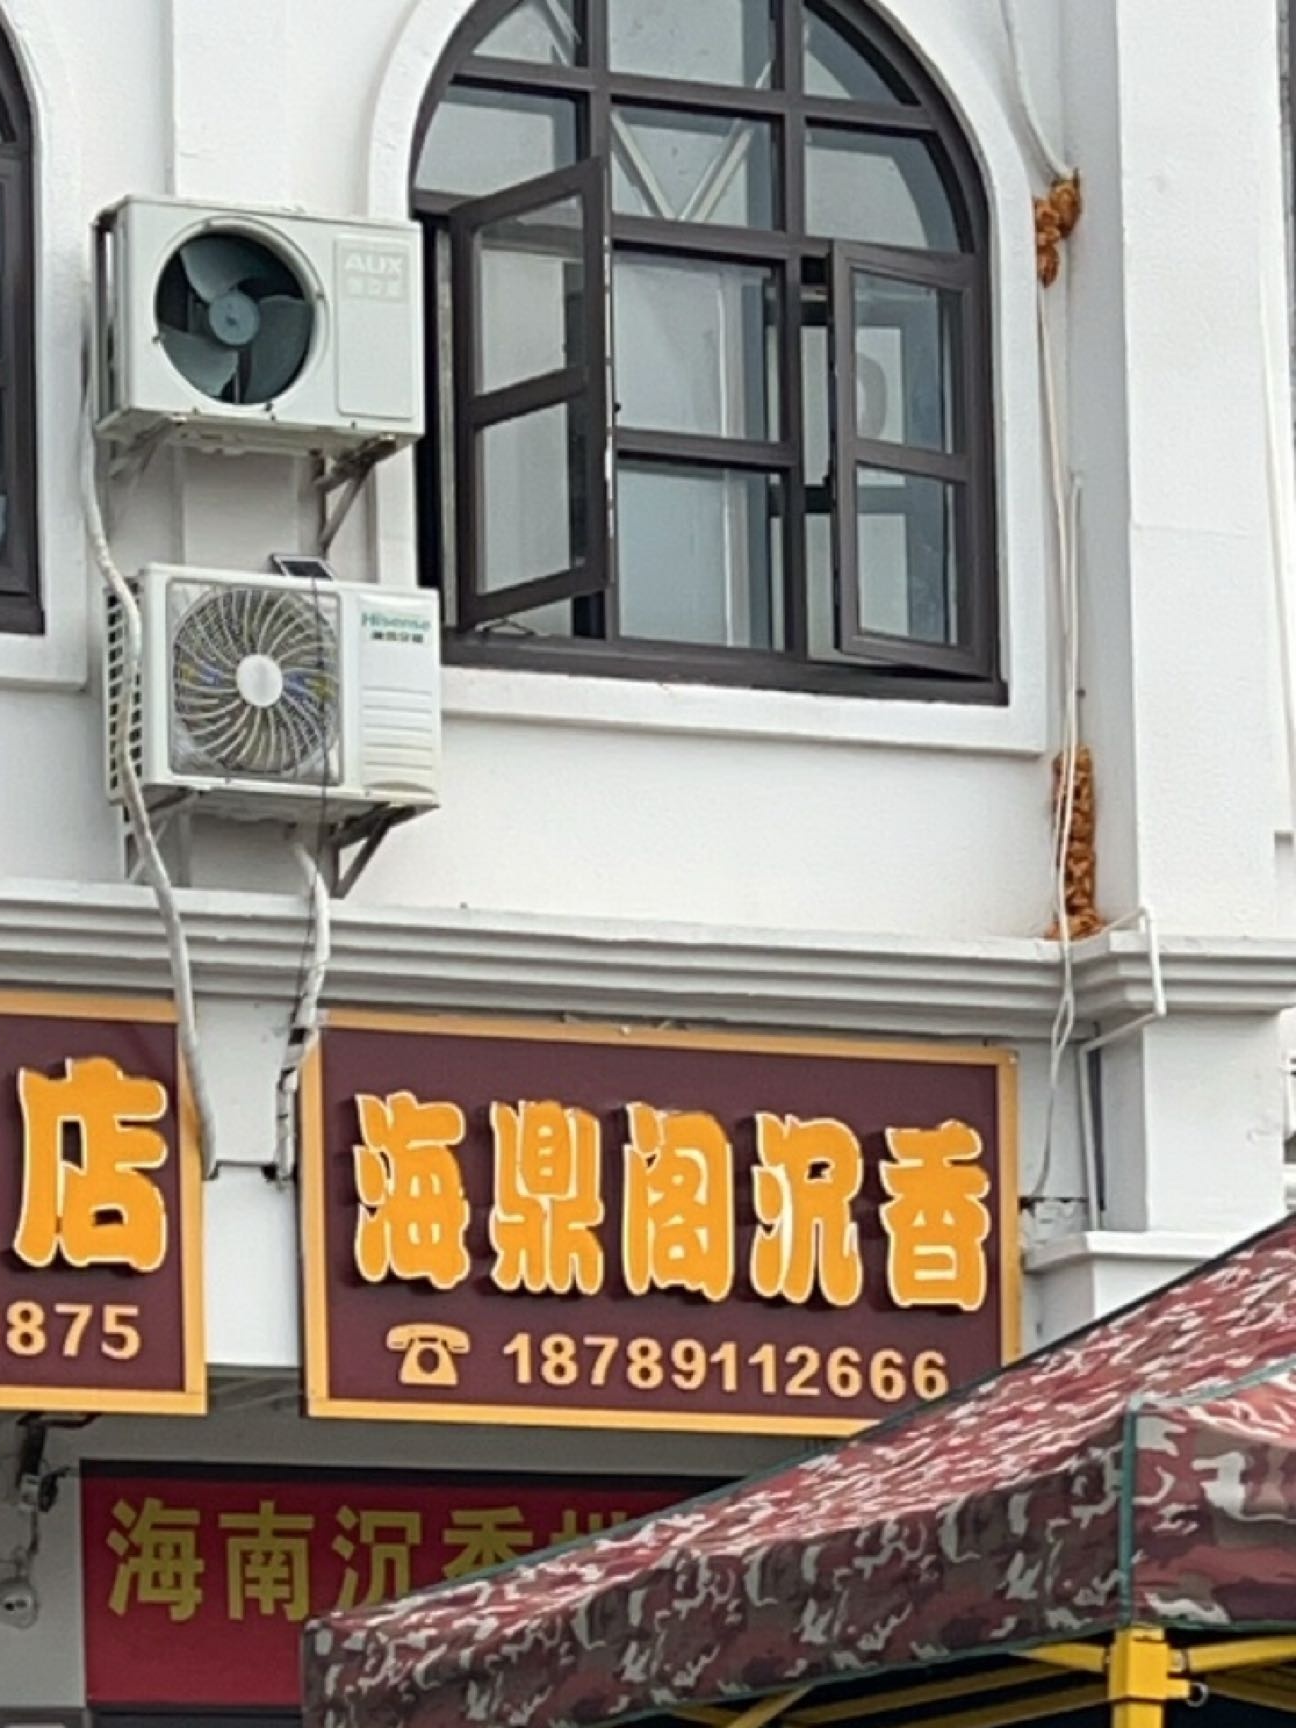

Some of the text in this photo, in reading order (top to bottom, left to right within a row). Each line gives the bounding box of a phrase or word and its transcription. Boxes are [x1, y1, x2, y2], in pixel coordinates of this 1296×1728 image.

[354, 1091, 989, 1311] 海鼎阁沉香
[502, 1332, 949, 1401] 18789112666
